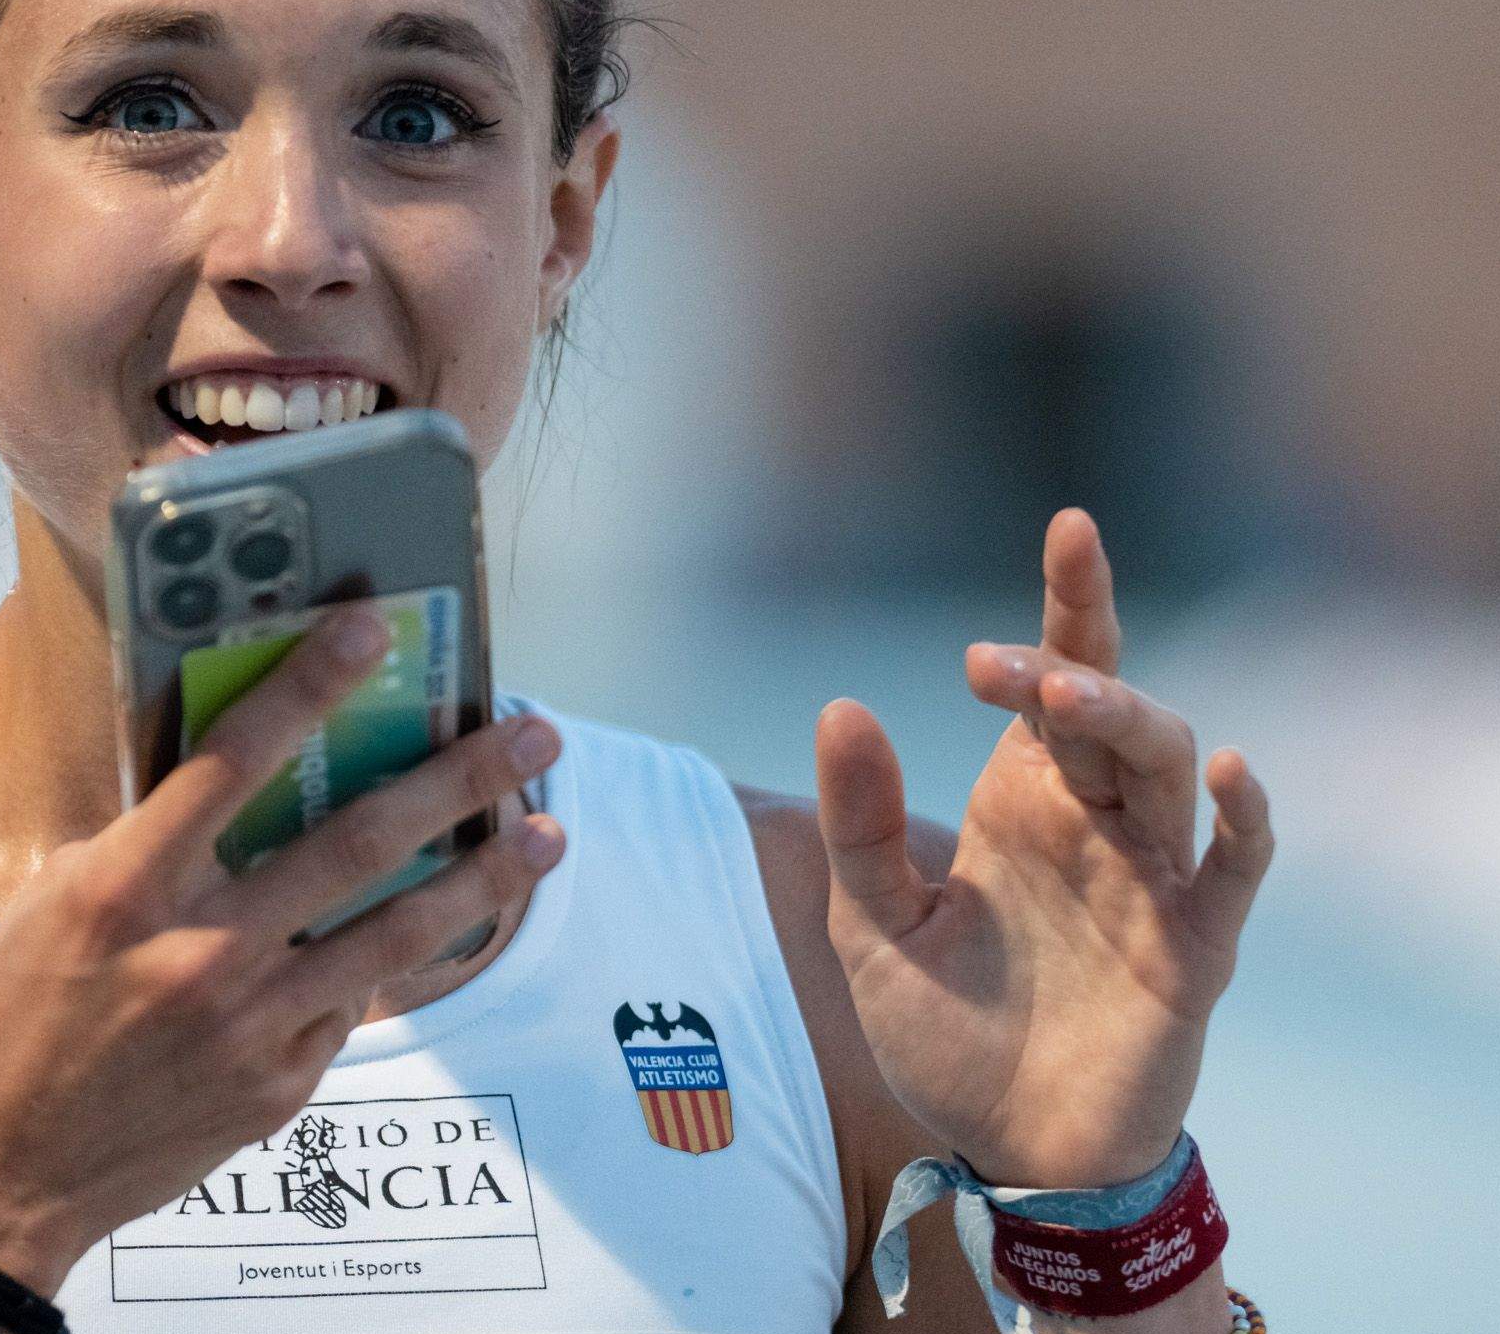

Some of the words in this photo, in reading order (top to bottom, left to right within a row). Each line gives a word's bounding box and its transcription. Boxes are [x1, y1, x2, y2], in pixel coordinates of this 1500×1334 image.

[628, 1055, 685, 1068] VALENCIA
[687, 1054, 719, 1067] CLUB
[638, 1070, 720, 1086] ATLETISMO
[433, 1117, 496, 1145] DE
[150, 1161, 513, 1216] ALÈNCIA
[1005, 1249, 1101, 1282] LLEGAMOS
[1013, 1241, 1081, 1266] JUNTOS
[238, 1261, 327, 1285] Joventut
[331, 1260, 338, 1278] i
[343, 1256, 423, 1281] Esports
[1026, 1272, 1082, 1296] LEJOS
